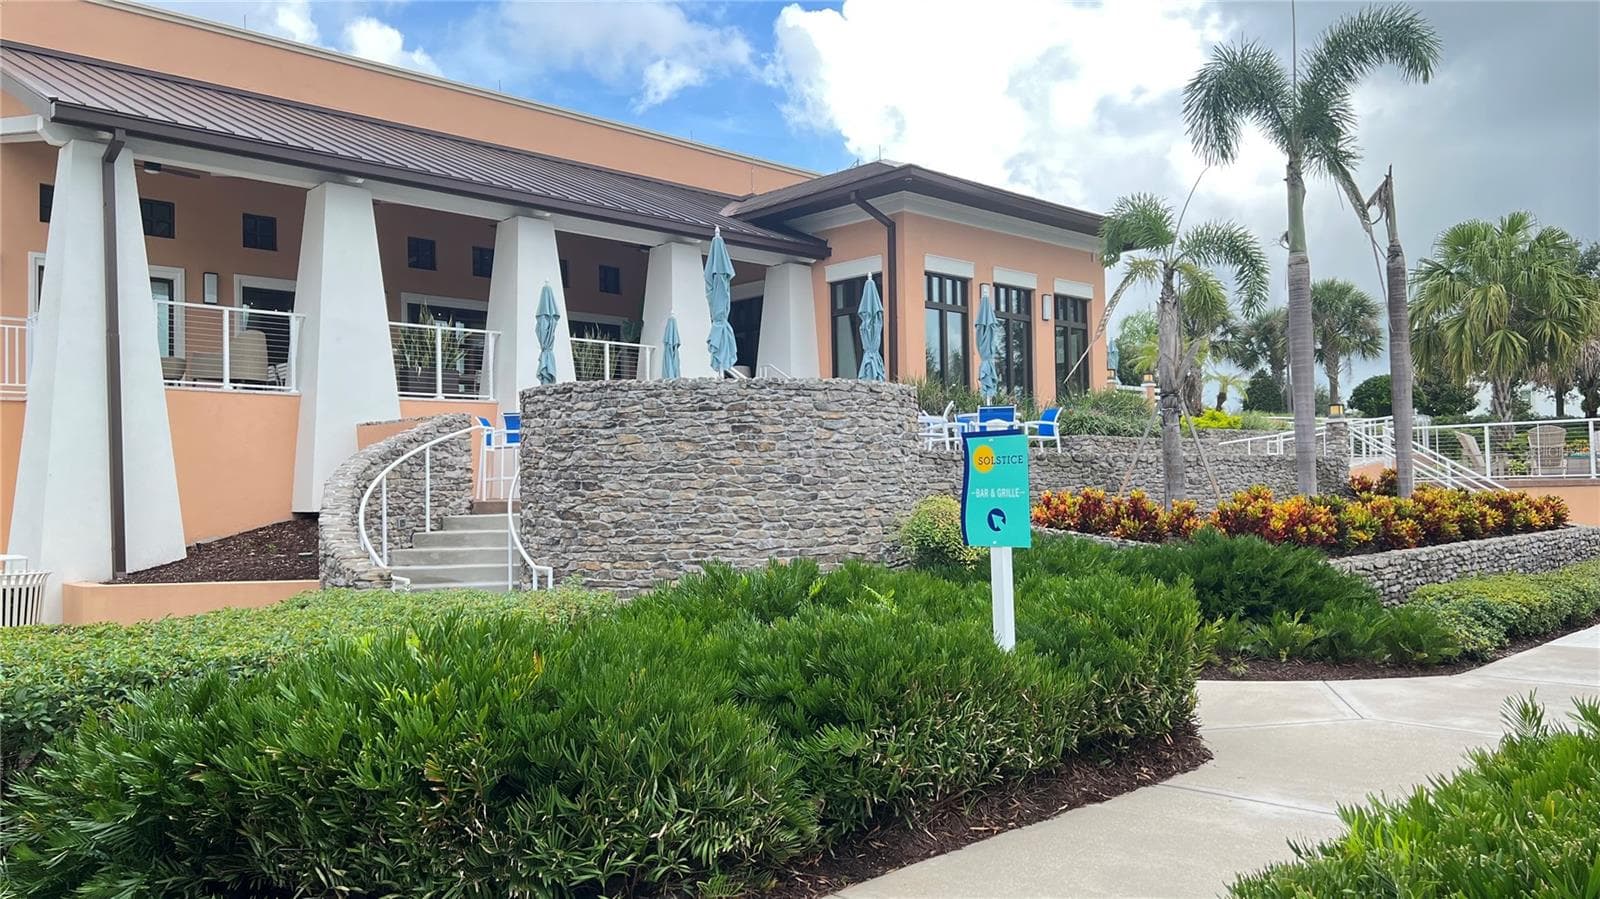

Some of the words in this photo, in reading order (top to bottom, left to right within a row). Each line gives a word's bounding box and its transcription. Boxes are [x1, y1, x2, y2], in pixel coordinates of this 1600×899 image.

[978, 455, 1024, 465] SOLSTICE
[975, 488, 989, 498] BAR
[990, 488, 995, 498] &
[997, 488, 1020, 498] GRILLE
